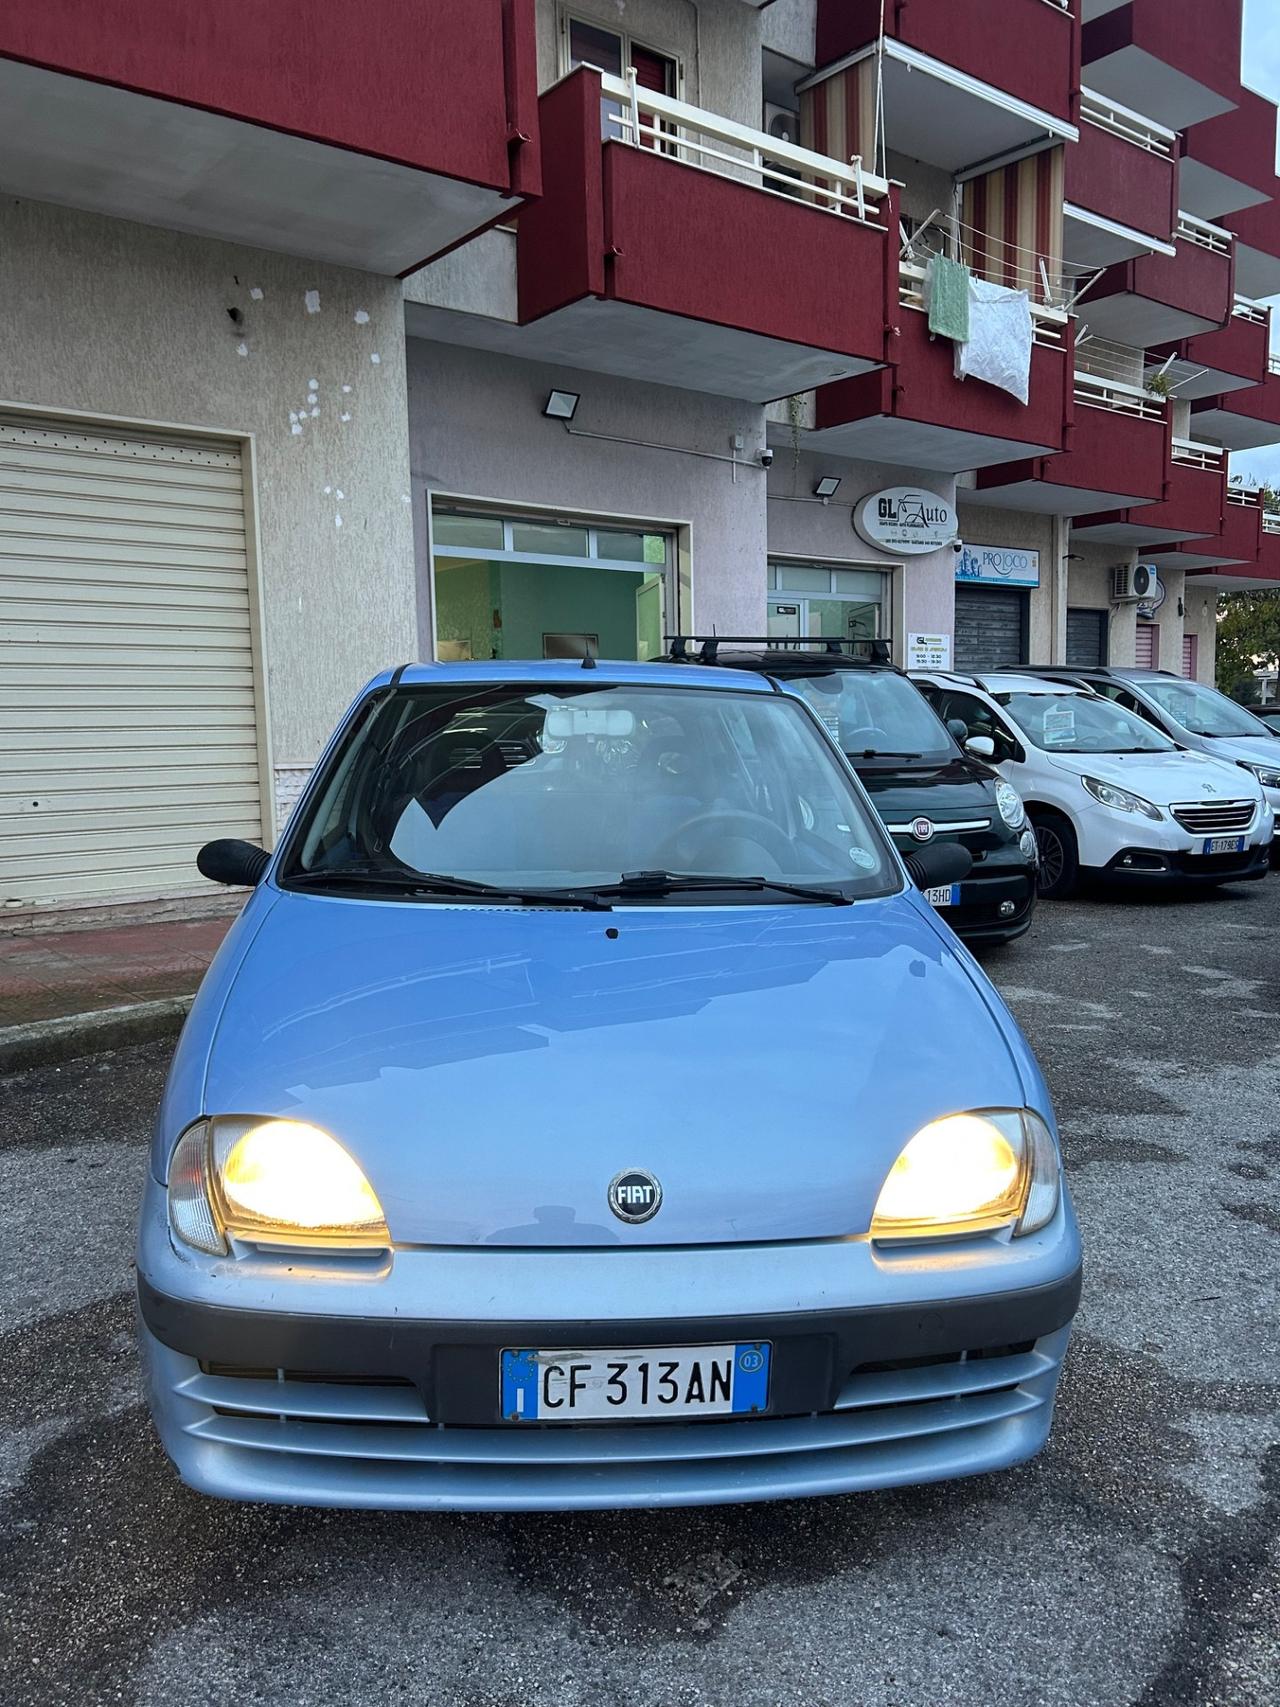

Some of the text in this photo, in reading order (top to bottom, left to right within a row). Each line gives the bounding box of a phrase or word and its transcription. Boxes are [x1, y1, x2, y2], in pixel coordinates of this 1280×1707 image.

[878, 498, 947, 527] GL Auto
[927, 888, 951, 903] 13HD
[617, 1185, 653, 1204] FIAT
[743, 1355, 759, 1368] 03
[543, 1359, 732, 1408] CF 313AN
